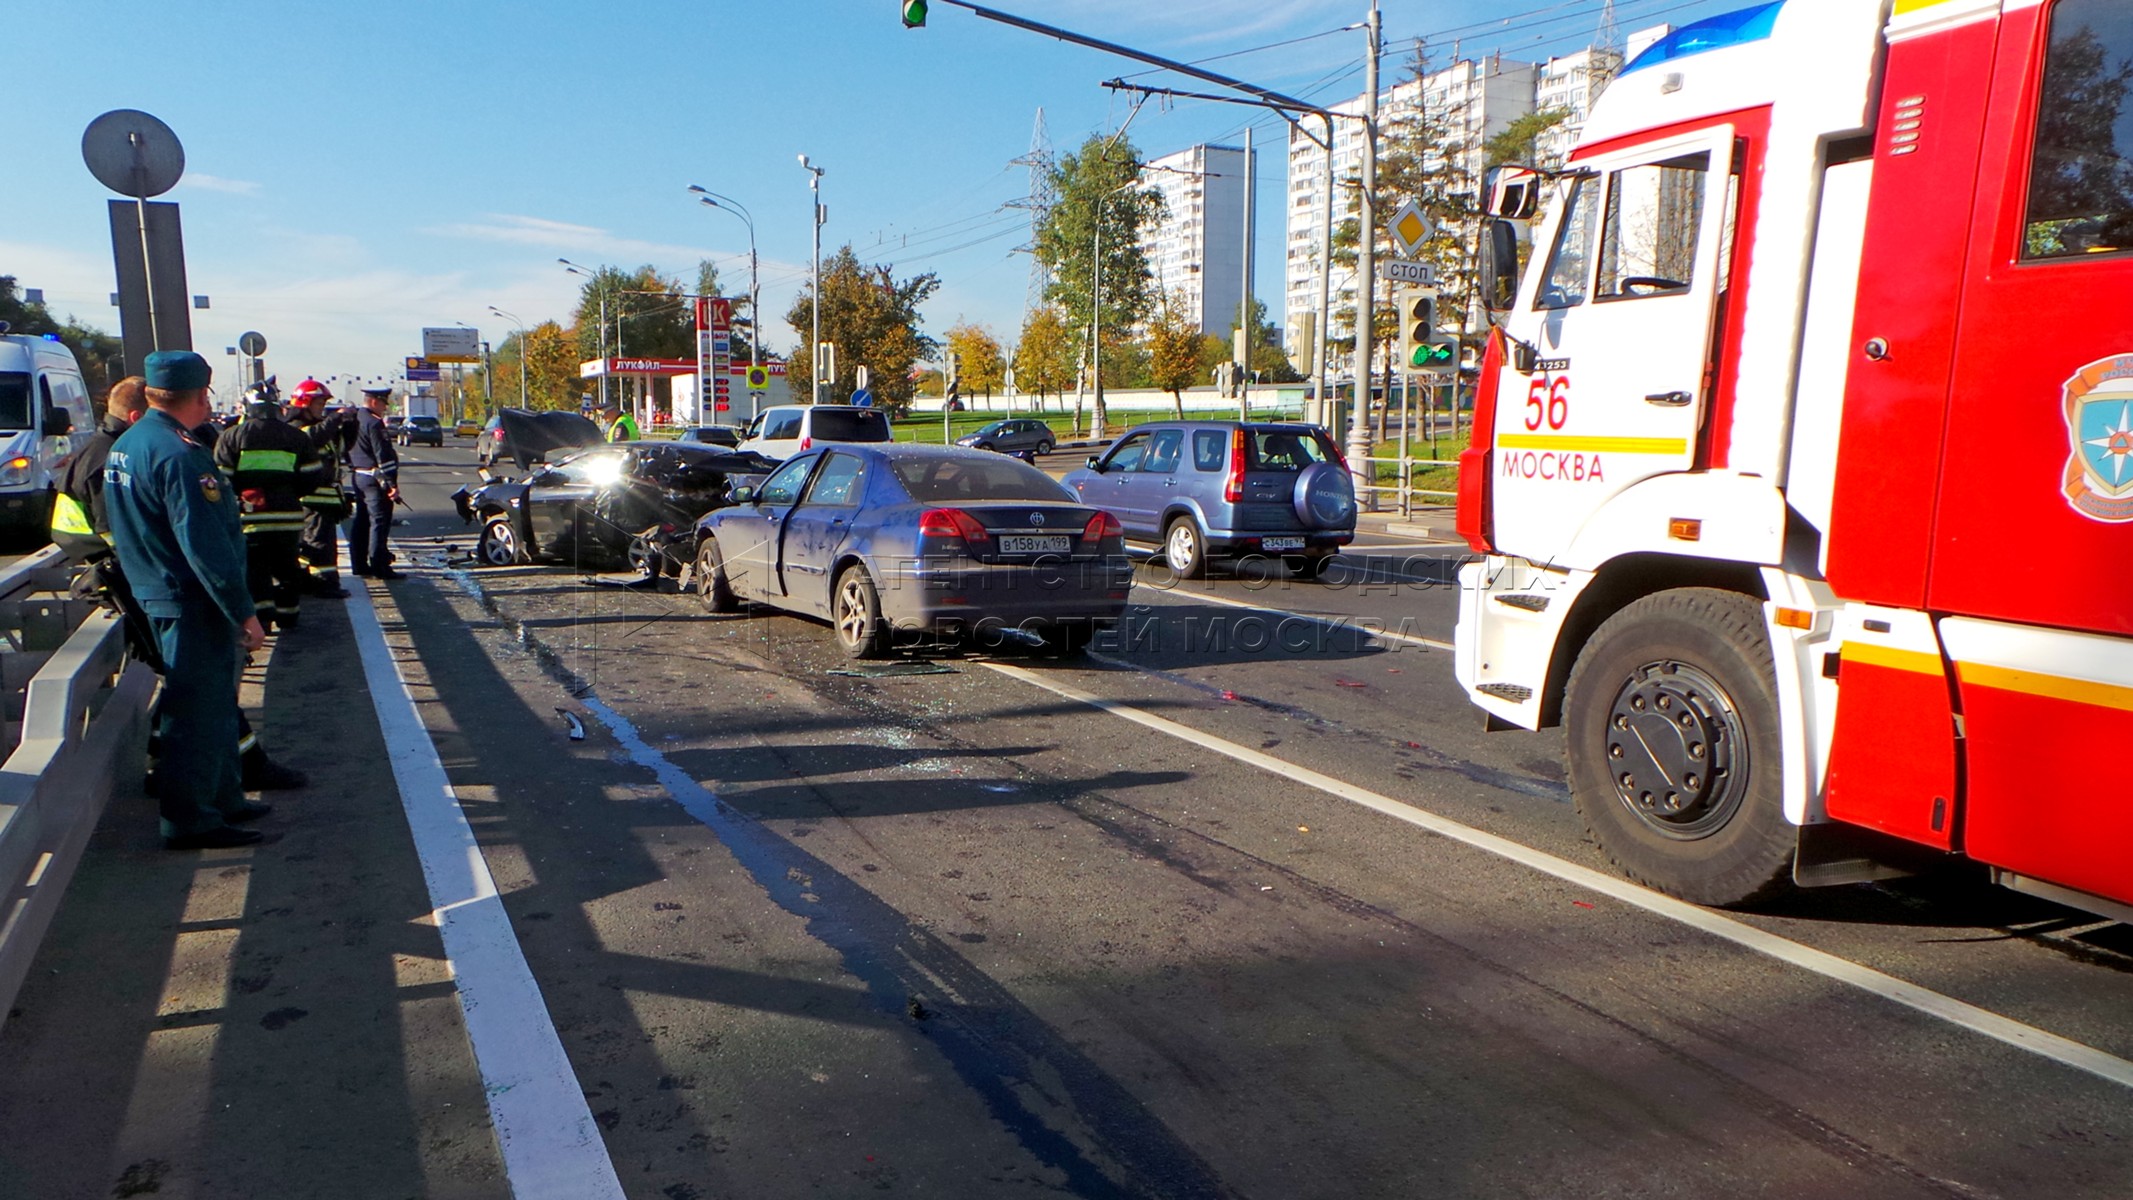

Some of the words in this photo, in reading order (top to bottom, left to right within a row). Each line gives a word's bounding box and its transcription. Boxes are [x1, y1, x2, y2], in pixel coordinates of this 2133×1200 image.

[1391, 263, 1428, 279] СТОП
[615, 360, 660, 370] ЛУКОЙЛ
[1525, 375, 1570, 431] 56
[1502, 451, 1604, 482] МОСКВА
